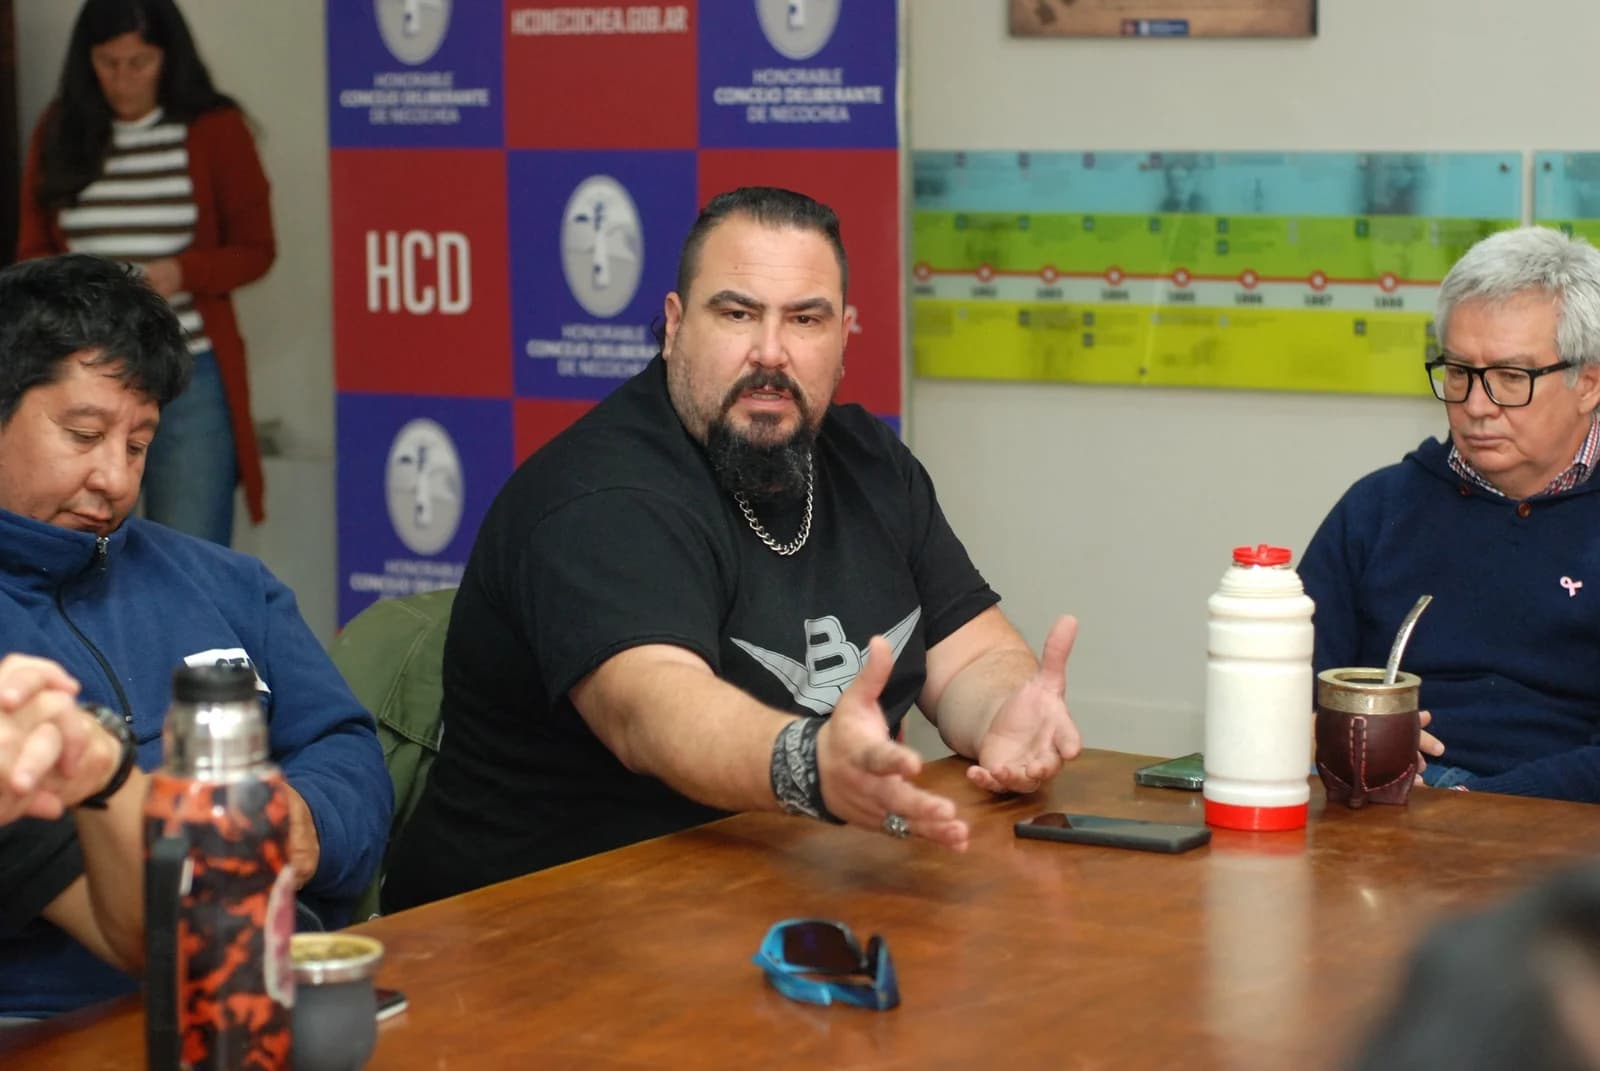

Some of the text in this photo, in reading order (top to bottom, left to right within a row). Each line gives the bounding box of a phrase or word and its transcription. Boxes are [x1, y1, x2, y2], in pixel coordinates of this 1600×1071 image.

[374, 72, 453, 87] HONORABLE
[752, 68, 843, 85] HONORABLE
[339, 88, 489, 107] CONCEJO DELIBERANTE
[713, 85, 883, 105] CONCEJO DELIBERANTE
[369, 107, 461, 124] DE NECOCHEA
[747, 105, 850, 122] DE NECOCHEA
[366, 230, 472, 315] HCD
[561, 323, 647, 342] HONORABLE
[526, 339, 590, 359] CONCEJO
[557, 359, 576, 376] DE
